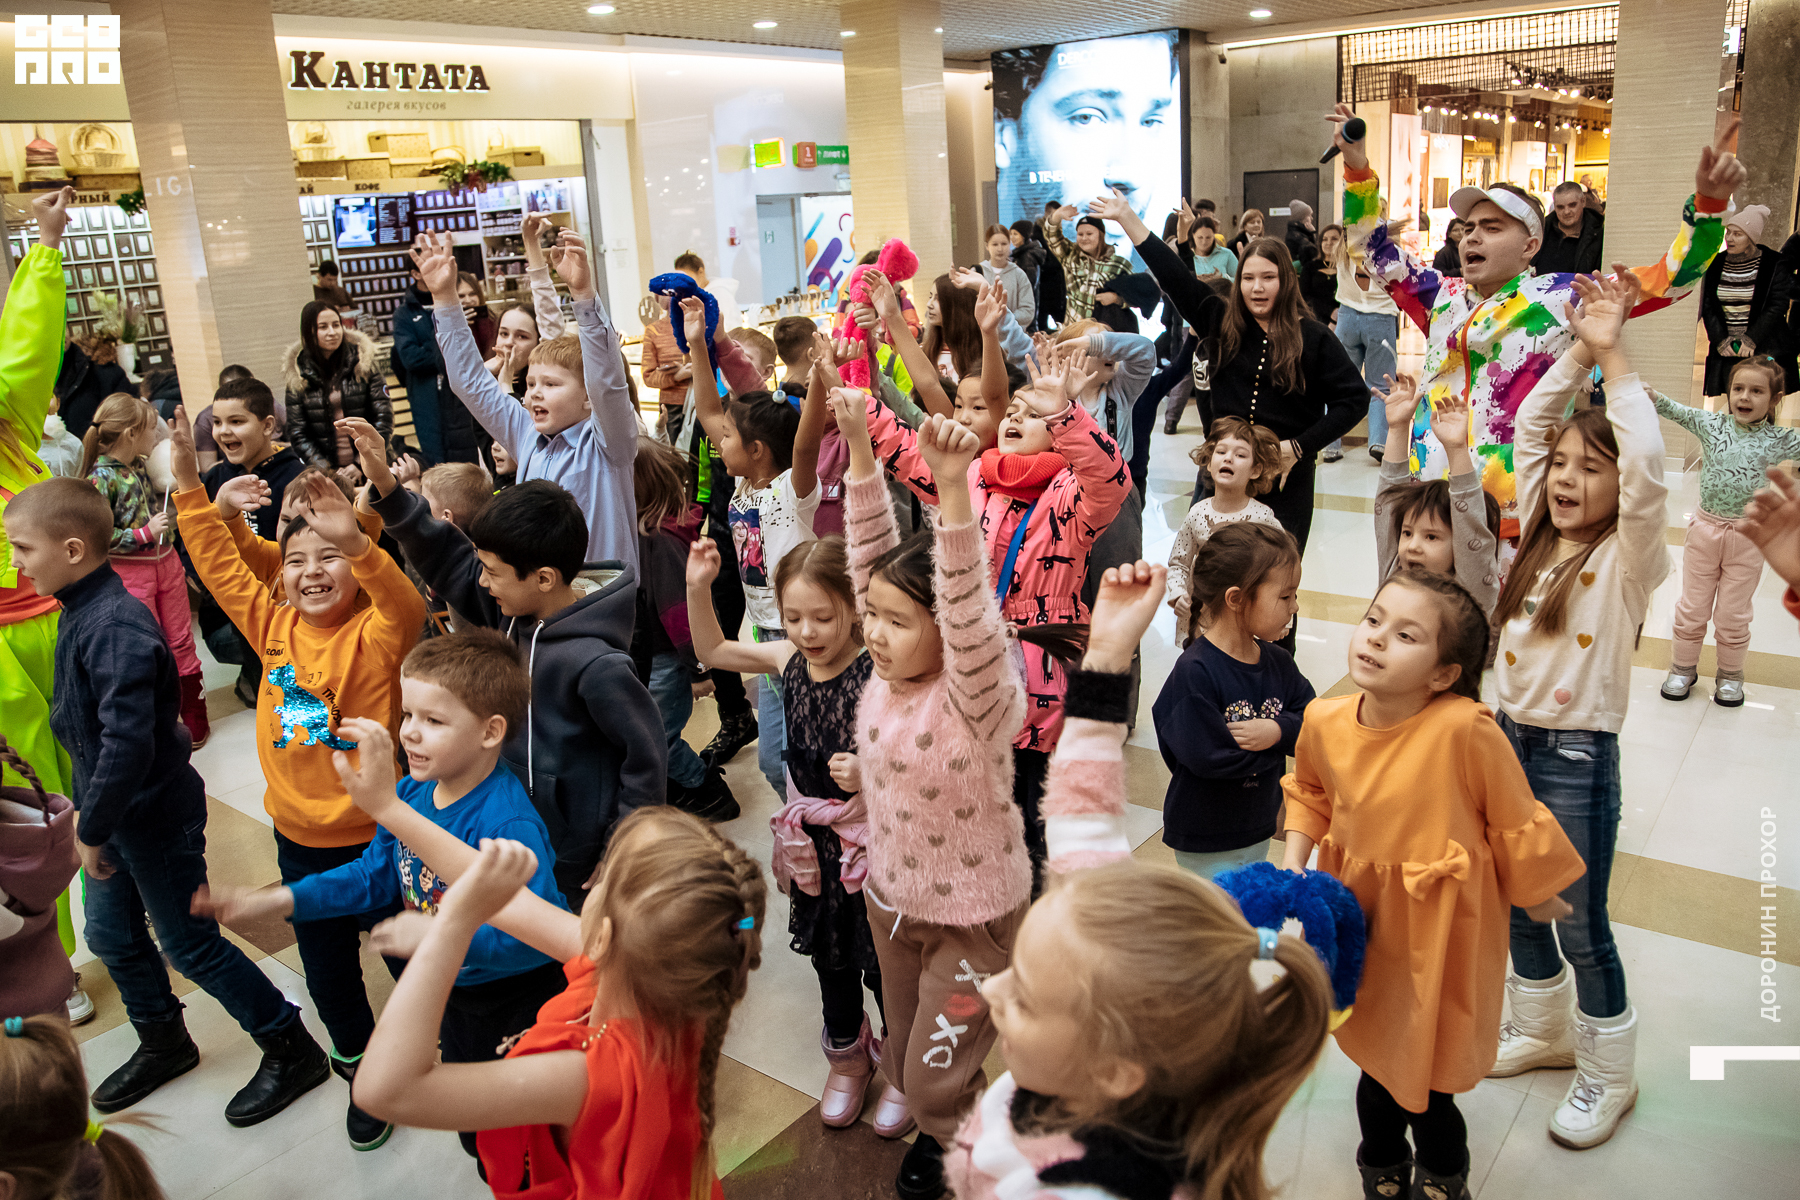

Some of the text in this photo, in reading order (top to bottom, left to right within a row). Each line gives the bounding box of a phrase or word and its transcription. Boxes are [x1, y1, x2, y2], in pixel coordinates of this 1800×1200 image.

[347, 99, 447, 112] галерея вкусов
[805, 146, 812, 157] 1
[355, 183, 380, 191] КОФЕ
[70, 191, 111, 204] РНЫЙ
